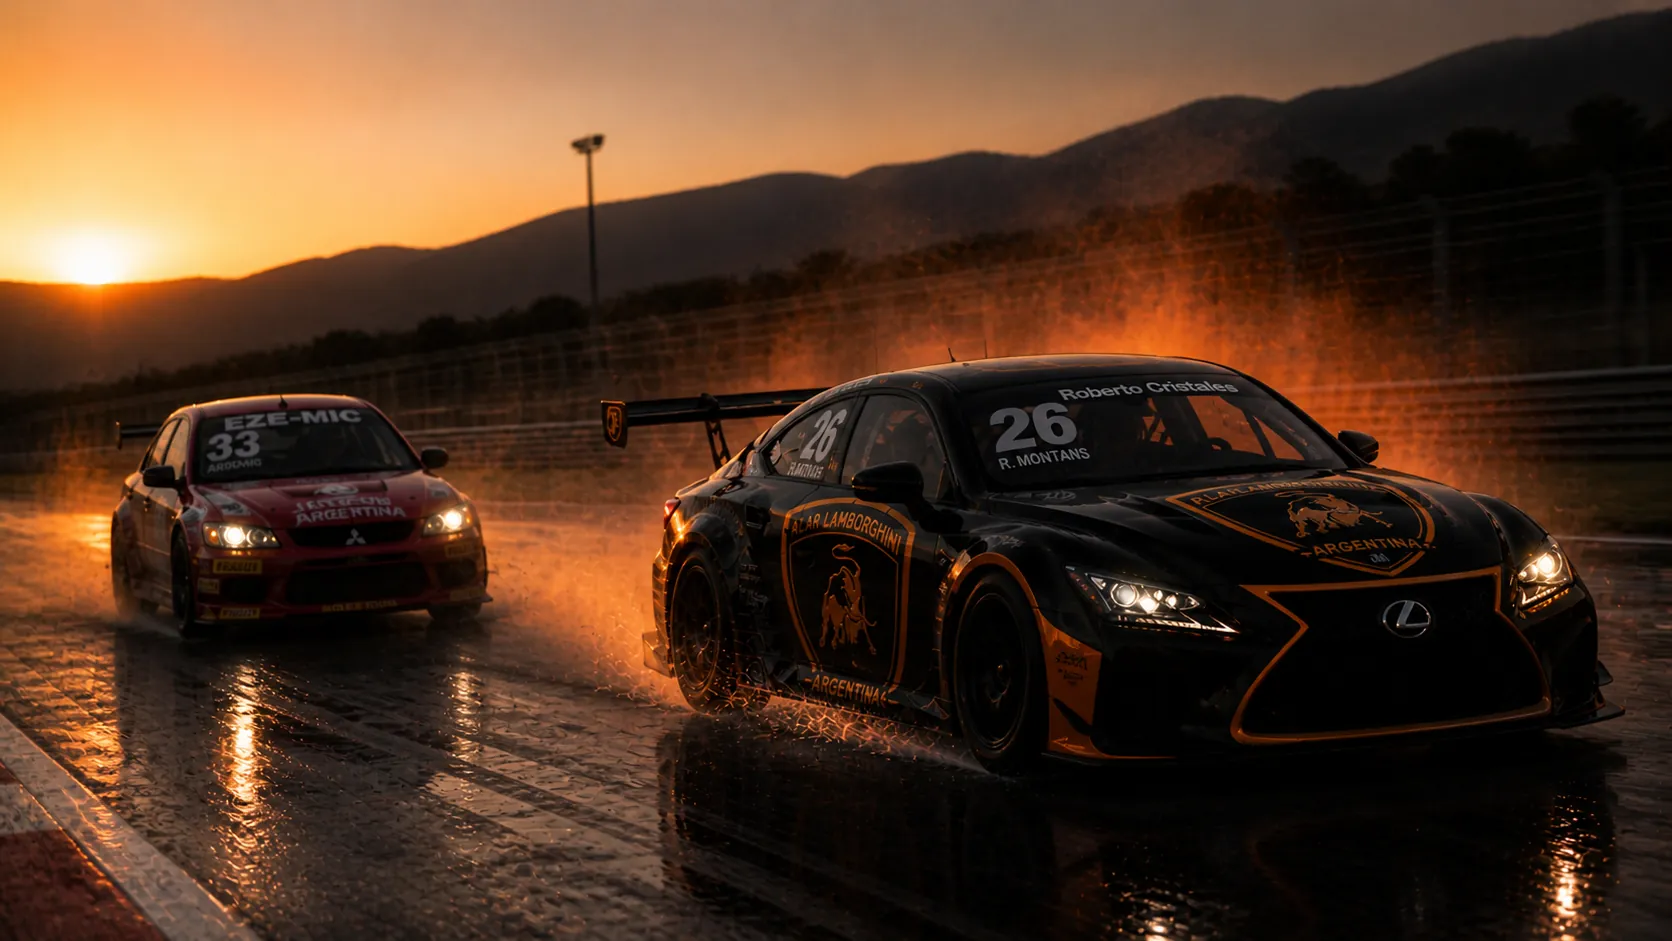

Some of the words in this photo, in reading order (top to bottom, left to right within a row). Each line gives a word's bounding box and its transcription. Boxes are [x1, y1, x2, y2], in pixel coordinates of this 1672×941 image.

[1057, 385, 1144, 401] Roberto
[1145, 381, 1240, 394] Cristales
[224, 408, 362, 431] EZE-MIC
[989, 402, 1077, 453] 26
[206, 430, 261, 462] 33
[800, 408, 848, 462] 26
[997, 457, 1016, 471] R.
[1018, 447, 1092, 468] MONTANS
[295, 506, 407, 528] ARGENTINA
[823, 511, 903, 555] LAMBORGHINI
